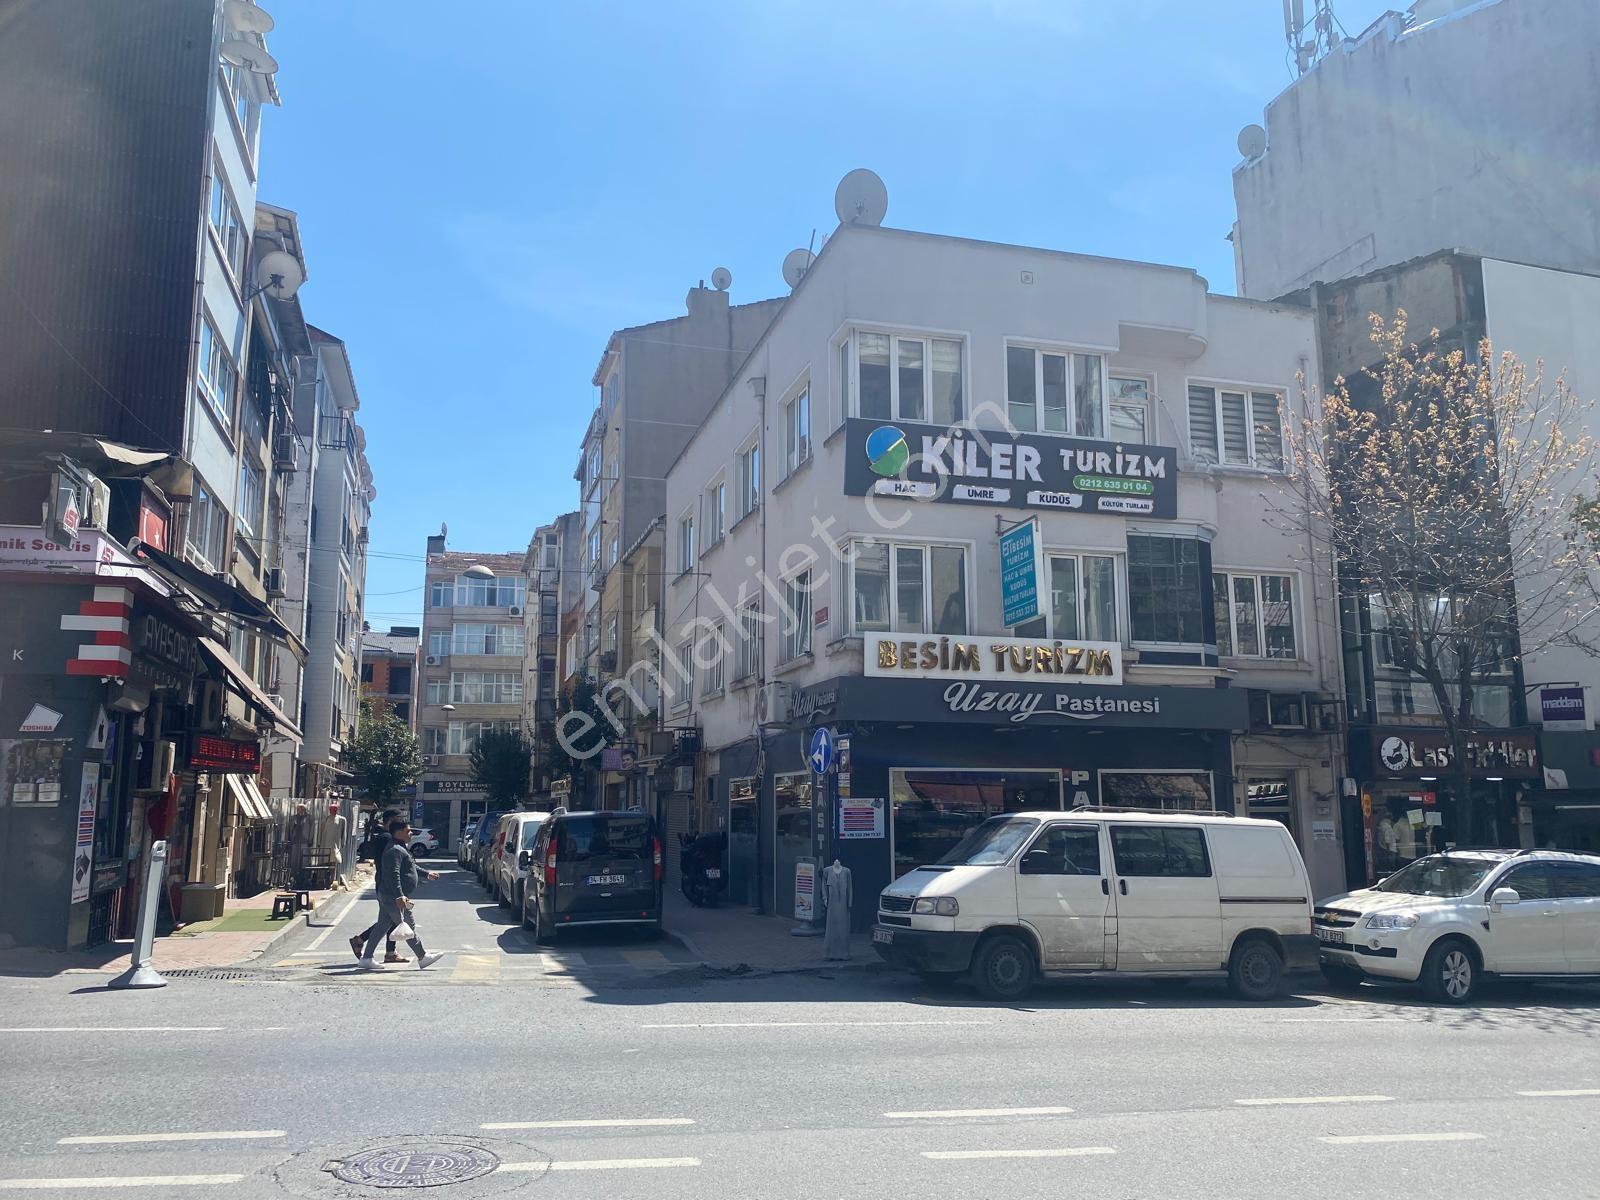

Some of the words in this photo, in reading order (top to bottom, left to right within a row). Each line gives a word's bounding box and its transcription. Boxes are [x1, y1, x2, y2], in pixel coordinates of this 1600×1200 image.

[921, 428, 1044, 483] KİLER
[1060, 445, 1166, 478] TURİZM
[894, 483, 917, 493] HAC
[1080, 478, 1102, 488] 0212
[1104, 480, 1121, 490] 635
[1123, 482, 1133, 490] 01
[1135, 482, 1147, 491] 04
[967, 489, 995, 499] UMRE
[1039, 494, 1071, 505] KUDÜS
[1101, 500, 1124, 508] KÜLTÜR
[1126, 502, 1150, 510] TURLARI
[32, 539, 91, 552] Seris
[1007, 550, 1030, 567] TURİZM
[13, 649, 24, 661] K
[878, 636, 981, 672] BESİM
[990, 640, 1114, 676] TURİZM
[943, 681, 1043, 722] Uzay
[1056, 694, 1160, 713] Pastanesi
[1543, 697, 1583, 709] maddam
